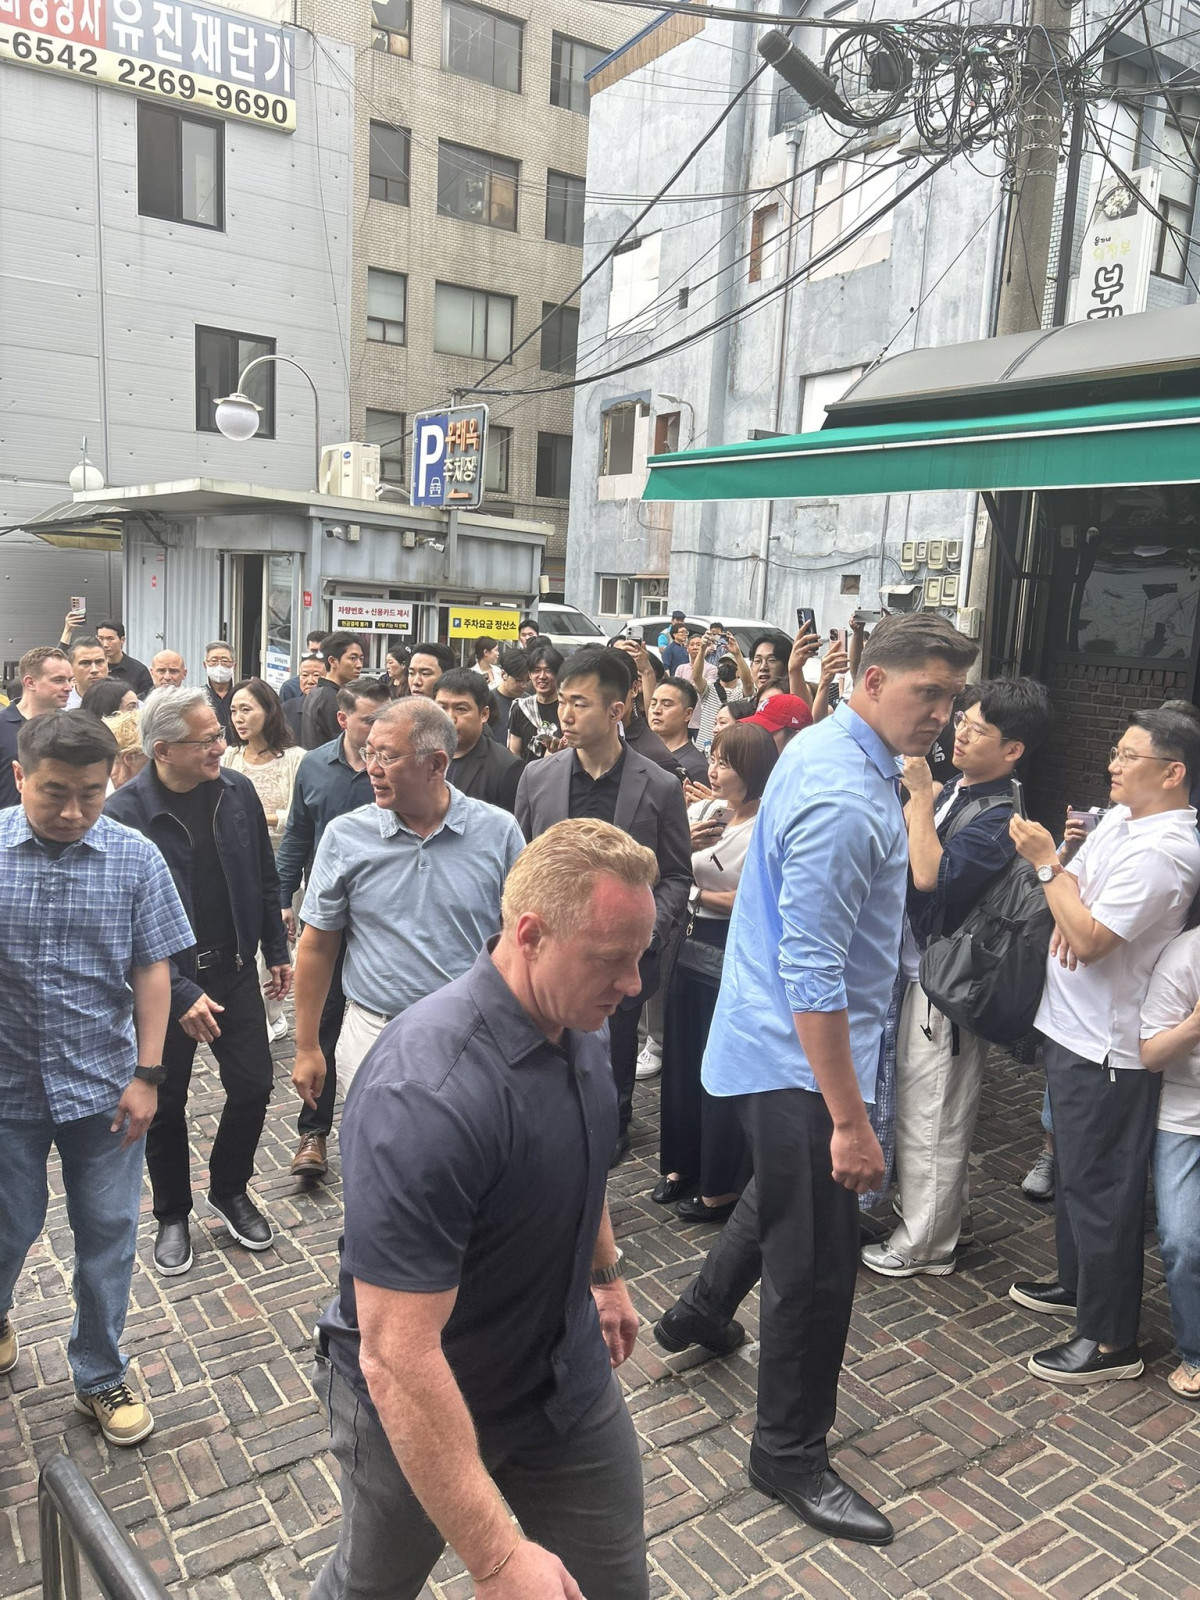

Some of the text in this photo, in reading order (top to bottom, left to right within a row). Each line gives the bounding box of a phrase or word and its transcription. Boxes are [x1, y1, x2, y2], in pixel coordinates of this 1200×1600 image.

[113, 0, 291, 93] 유진재단기
[117, 58, 289, 124] 2269-9690
[444, 418, 479, 453] 우래옥
[418, 425, 444, 497] P
[443, 456, 477, 483] 주차장
[338, 606, 364, 614] 차량번호
[370, 608, 395, 617] 신용카드
[397, 609, 410, 618] 제시
[464, 618, 493, 629] 주차요금
[495, 620, 517, 630] 정산소
